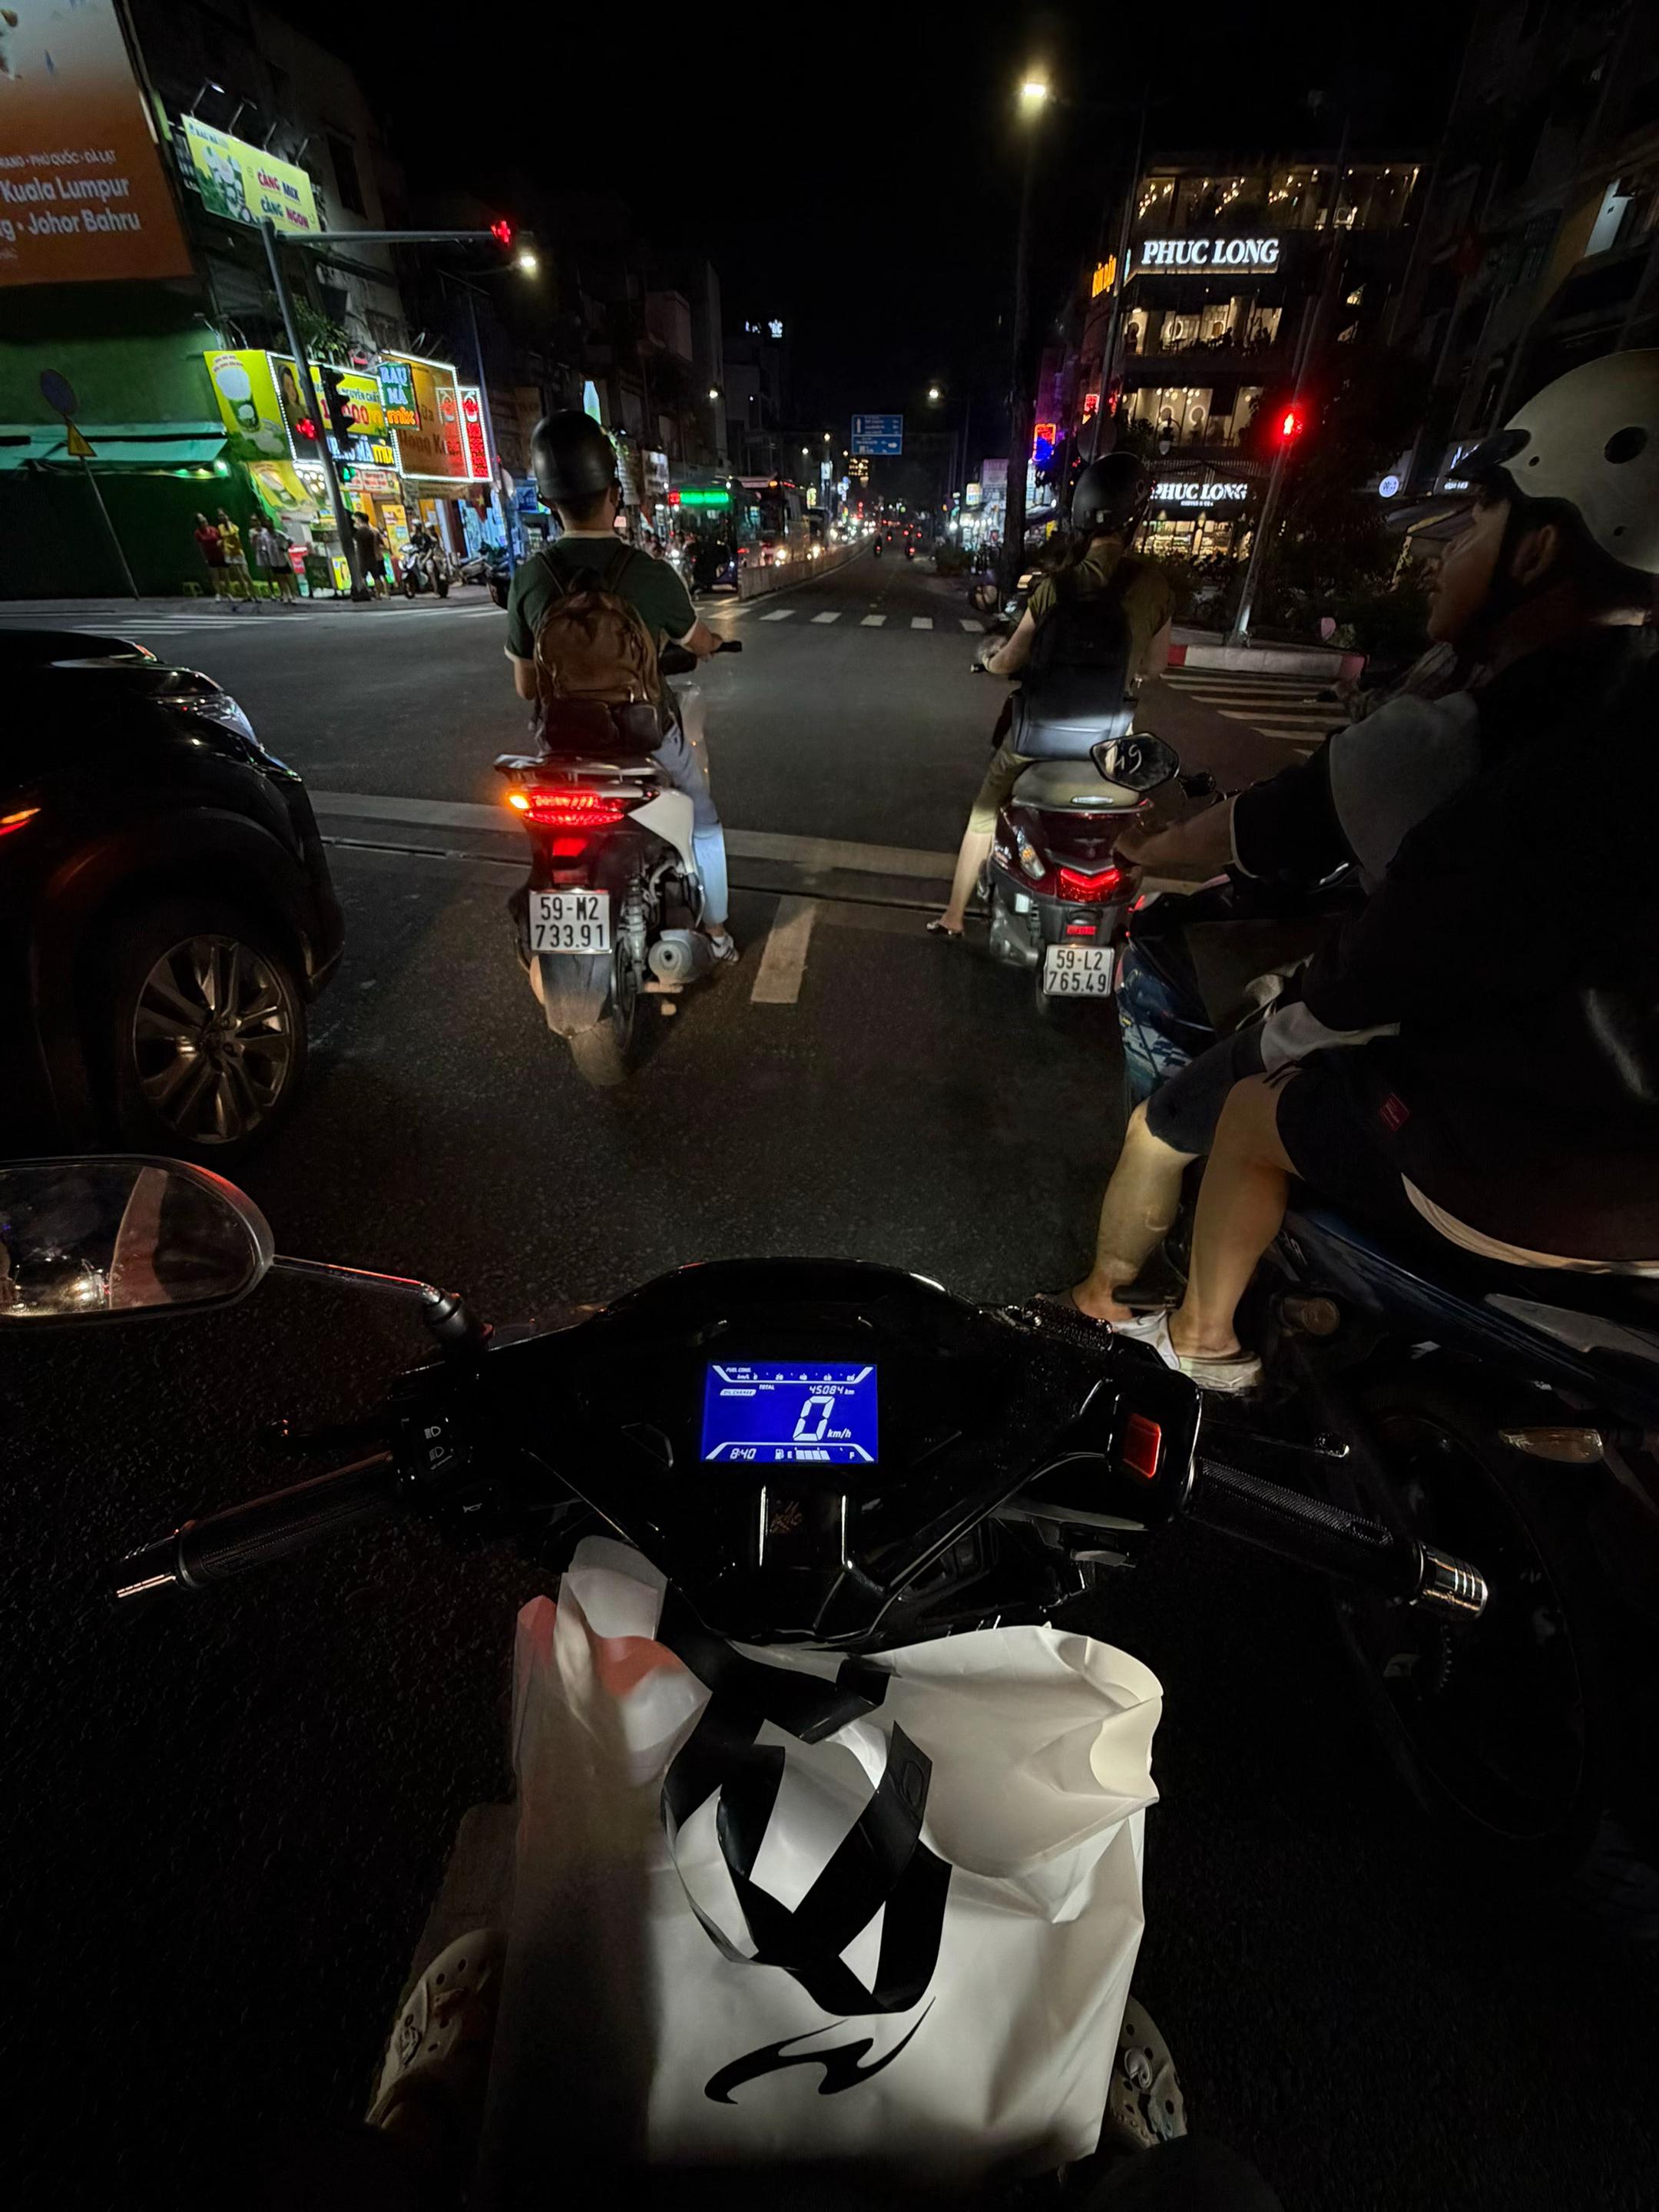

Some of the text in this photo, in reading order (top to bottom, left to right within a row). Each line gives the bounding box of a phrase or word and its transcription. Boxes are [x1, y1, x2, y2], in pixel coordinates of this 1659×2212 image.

[1, 177, 130, 204] Kuala Lumpur
[282, 181, 300, 201] MIX
[28, 210, 80, 235] Johor
[81, 207, 142, 232] Bahru
[1141, 240, 1280, 264] PHUC LONG
[387, 406, 416, 425] mix
[370, 438, 394, 465] mix
[1200, 482, 1248, 500] LONG
[540, 896, 600, 921] 59-M2
[535, 924, 604, 949] 733.91
[1056, 949, 1103, 971] 59-L2
[1048, 971, 1107, 993] 765.49
[809, 1385, 844, 1395] 45084
[793, 1396, 853, 1442] 0 km/h
[730, 1448, 757, 1460] 8:40
[786, 1450, 855, 1459] E F
